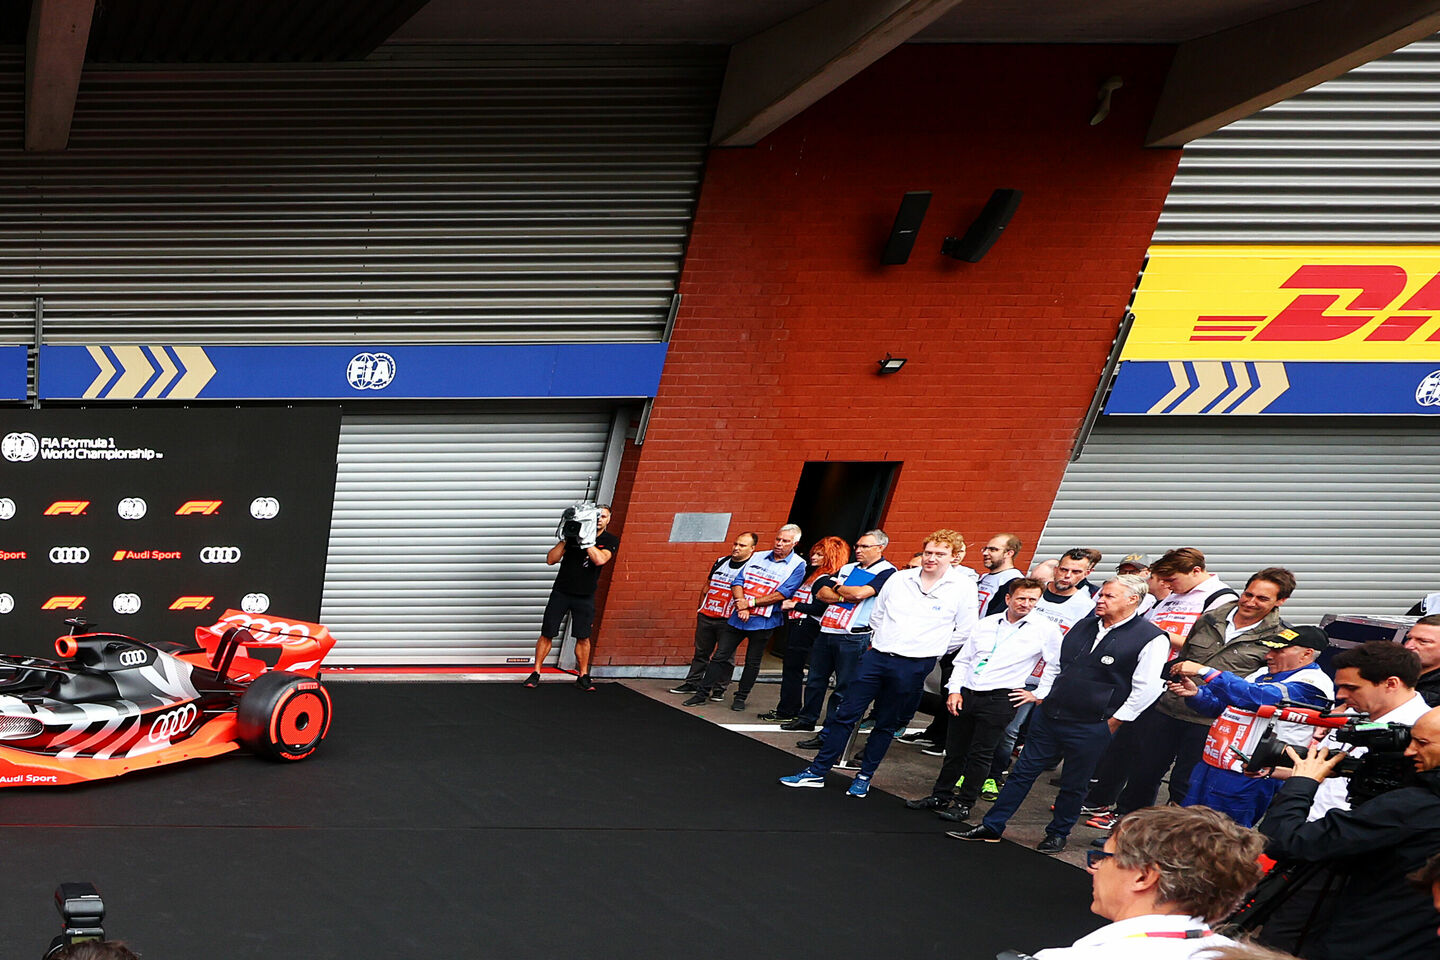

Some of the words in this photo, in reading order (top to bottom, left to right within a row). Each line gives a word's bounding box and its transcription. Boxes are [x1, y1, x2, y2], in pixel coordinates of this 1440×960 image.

[40, 437, 61, 449] FIA
[61, 437, 108, 449] Formula
[108, 437, 116, 448] 1
[40, 449, 73, 460] World
[126, 550, 150, 560] Audi
[151, 550, 182, 561] Sport
[1287, 711, 1309, 724] RTL
[25, 774, 58, 785] Sport
